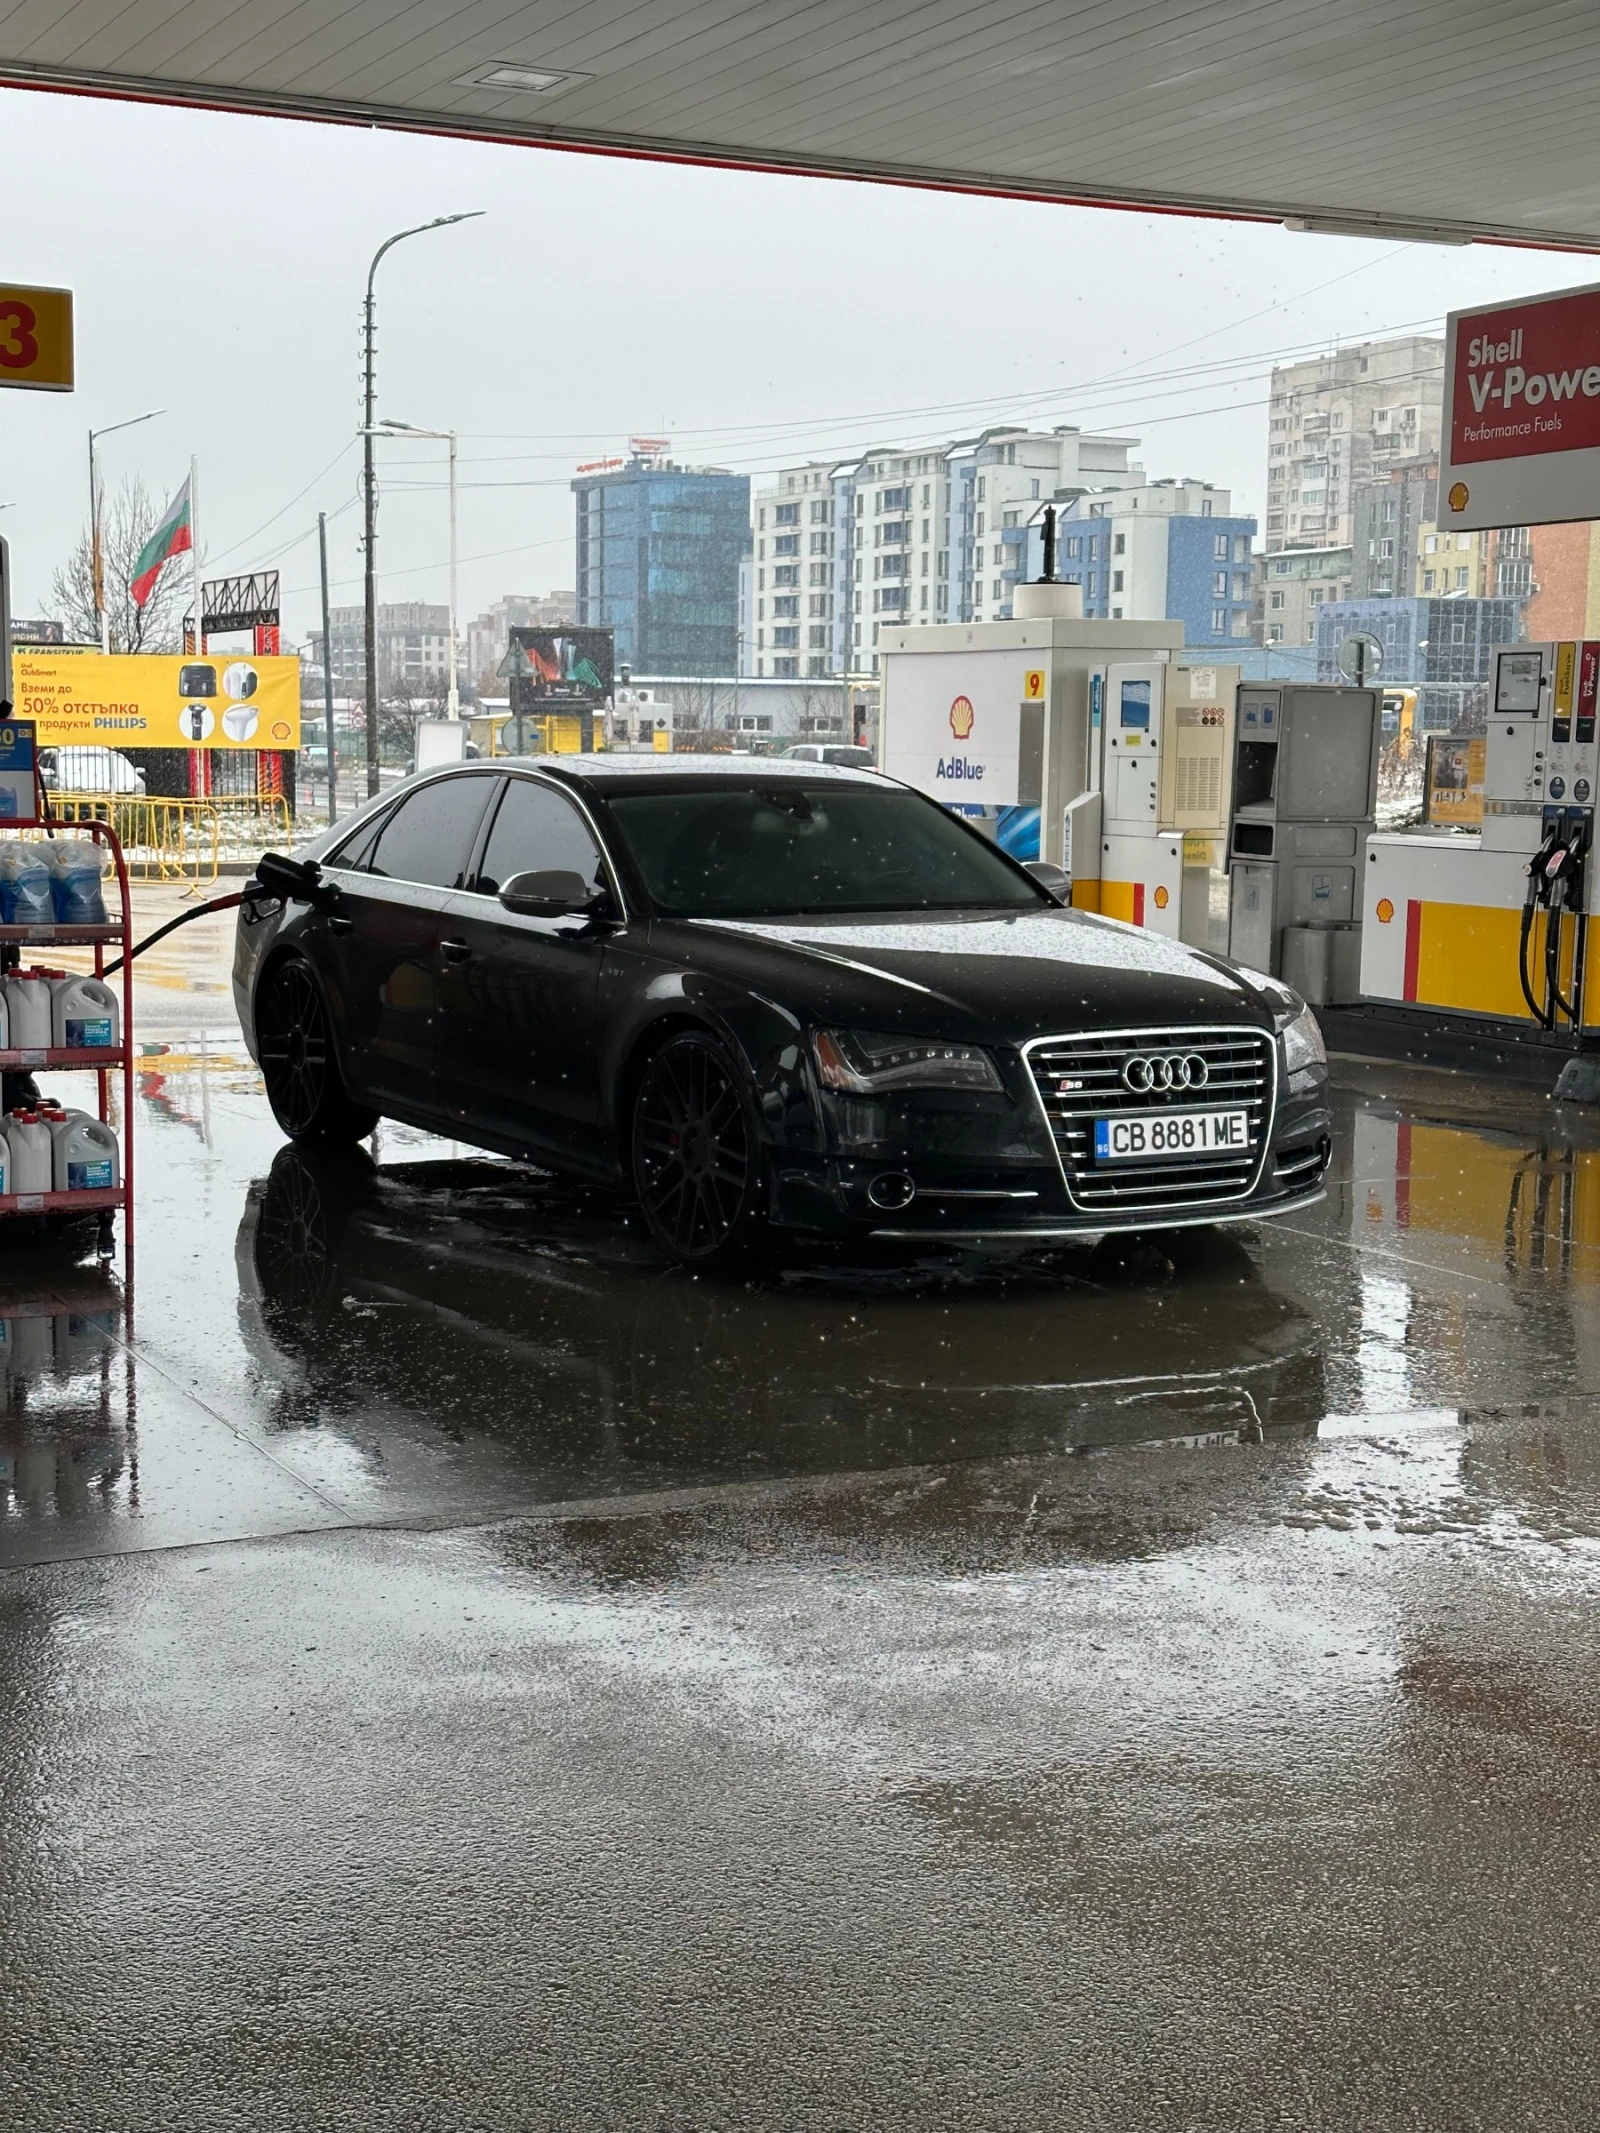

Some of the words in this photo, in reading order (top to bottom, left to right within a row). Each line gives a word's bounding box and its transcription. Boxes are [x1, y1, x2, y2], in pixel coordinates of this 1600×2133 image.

[0, 300, 39, 369] 3
[1468, 328, 1523, 368] Shell
[1468, 365, 1600, 413] V-Powe
[1464, 422, 1531, 442] Performance
[1534, 411, 1562, 433] Fuels
[1030, 673, 1040, 696] 9
[1563, 653, 1571, 695] FuelSave
[1587, 656, 1596, 697] V-Power
[21, 682, 55, 693] Вземи
[58, 685, 72, 695] до
[22, 697, 59, 714] 50%
[63, 702, 139, 714] отстъпка
[0, 728, 15, 745] 0
[39, 720, 91, 732] продукти
[94, 717, 148, 729] PHILIPS
[936, 757, 983, 780] AdBlue
[1113, 1123, 1146, 1153] CB
[1151, 1118, 1207, 1150] 8881
[1214, 1115, 1244, 1146] ME
[1097, 1144, 1108, 1153] BG
